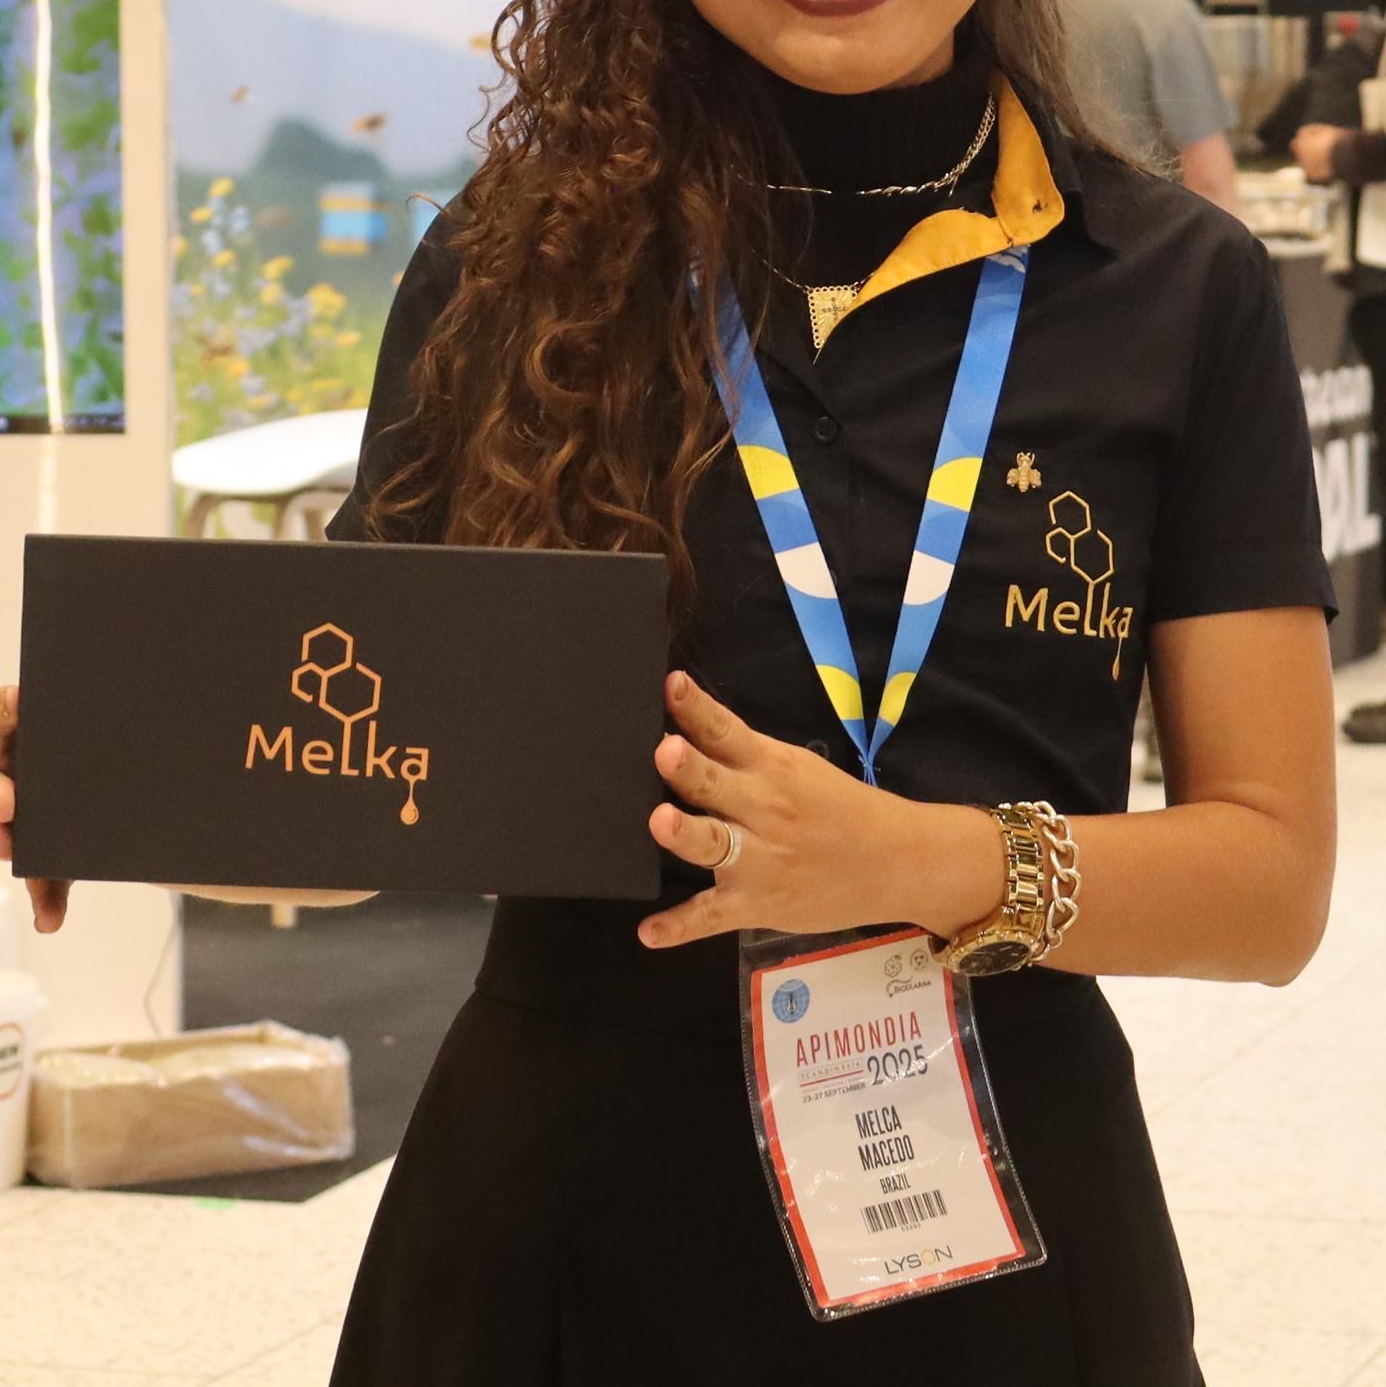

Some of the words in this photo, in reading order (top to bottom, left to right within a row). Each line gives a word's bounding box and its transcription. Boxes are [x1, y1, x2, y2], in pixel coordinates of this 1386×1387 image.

[244, 719, 430, 782] Melka
[797, 1010, 923, 1068] APIMONDIA
[866, 1043, 929, 1087] 2025
[855, 1104, 903, 1140] MELCA
[858, 1134, 915, 1171] MACEDO
[879, 1172, 912, 1195] BRAZIL
